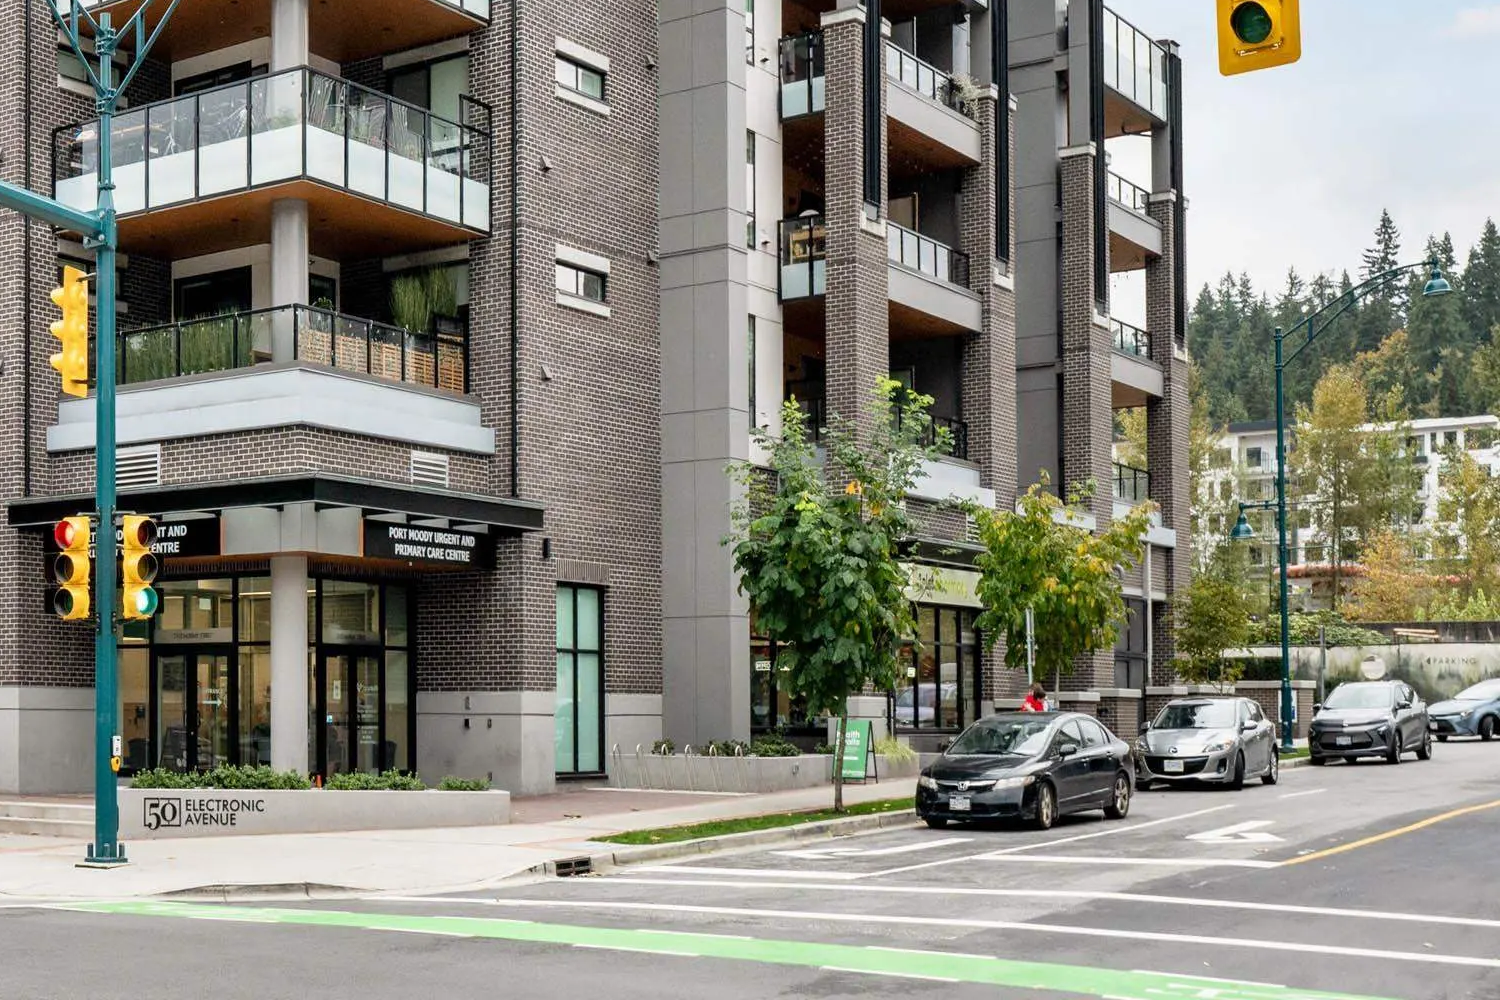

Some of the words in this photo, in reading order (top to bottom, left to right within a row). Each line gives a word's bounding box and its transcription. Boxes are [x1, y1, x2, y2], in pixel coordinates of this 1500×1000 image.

[168, 525, 187, 537] AND
[388, 526, 408, 540] PORT
[408, 528, 434, 543] MOODY
[434, 532, 461, 545] URGENT
[461, 535, 475, 547] AND
[151, 541, 180, 554] ENTRE
[394, 543, 426, 557] PRIMARY
[426, 547, 445, 560] CARE
[445, 549, 470, 562] CENTRE
[1433, 656, 1477, 665] PARKING
[836, 730, 860, 739] halth
[146, 801, 179, 830] 50
[185, 799, 265, 813] ELECTRONIC
[184, 813, 237, 826] AVENUE
